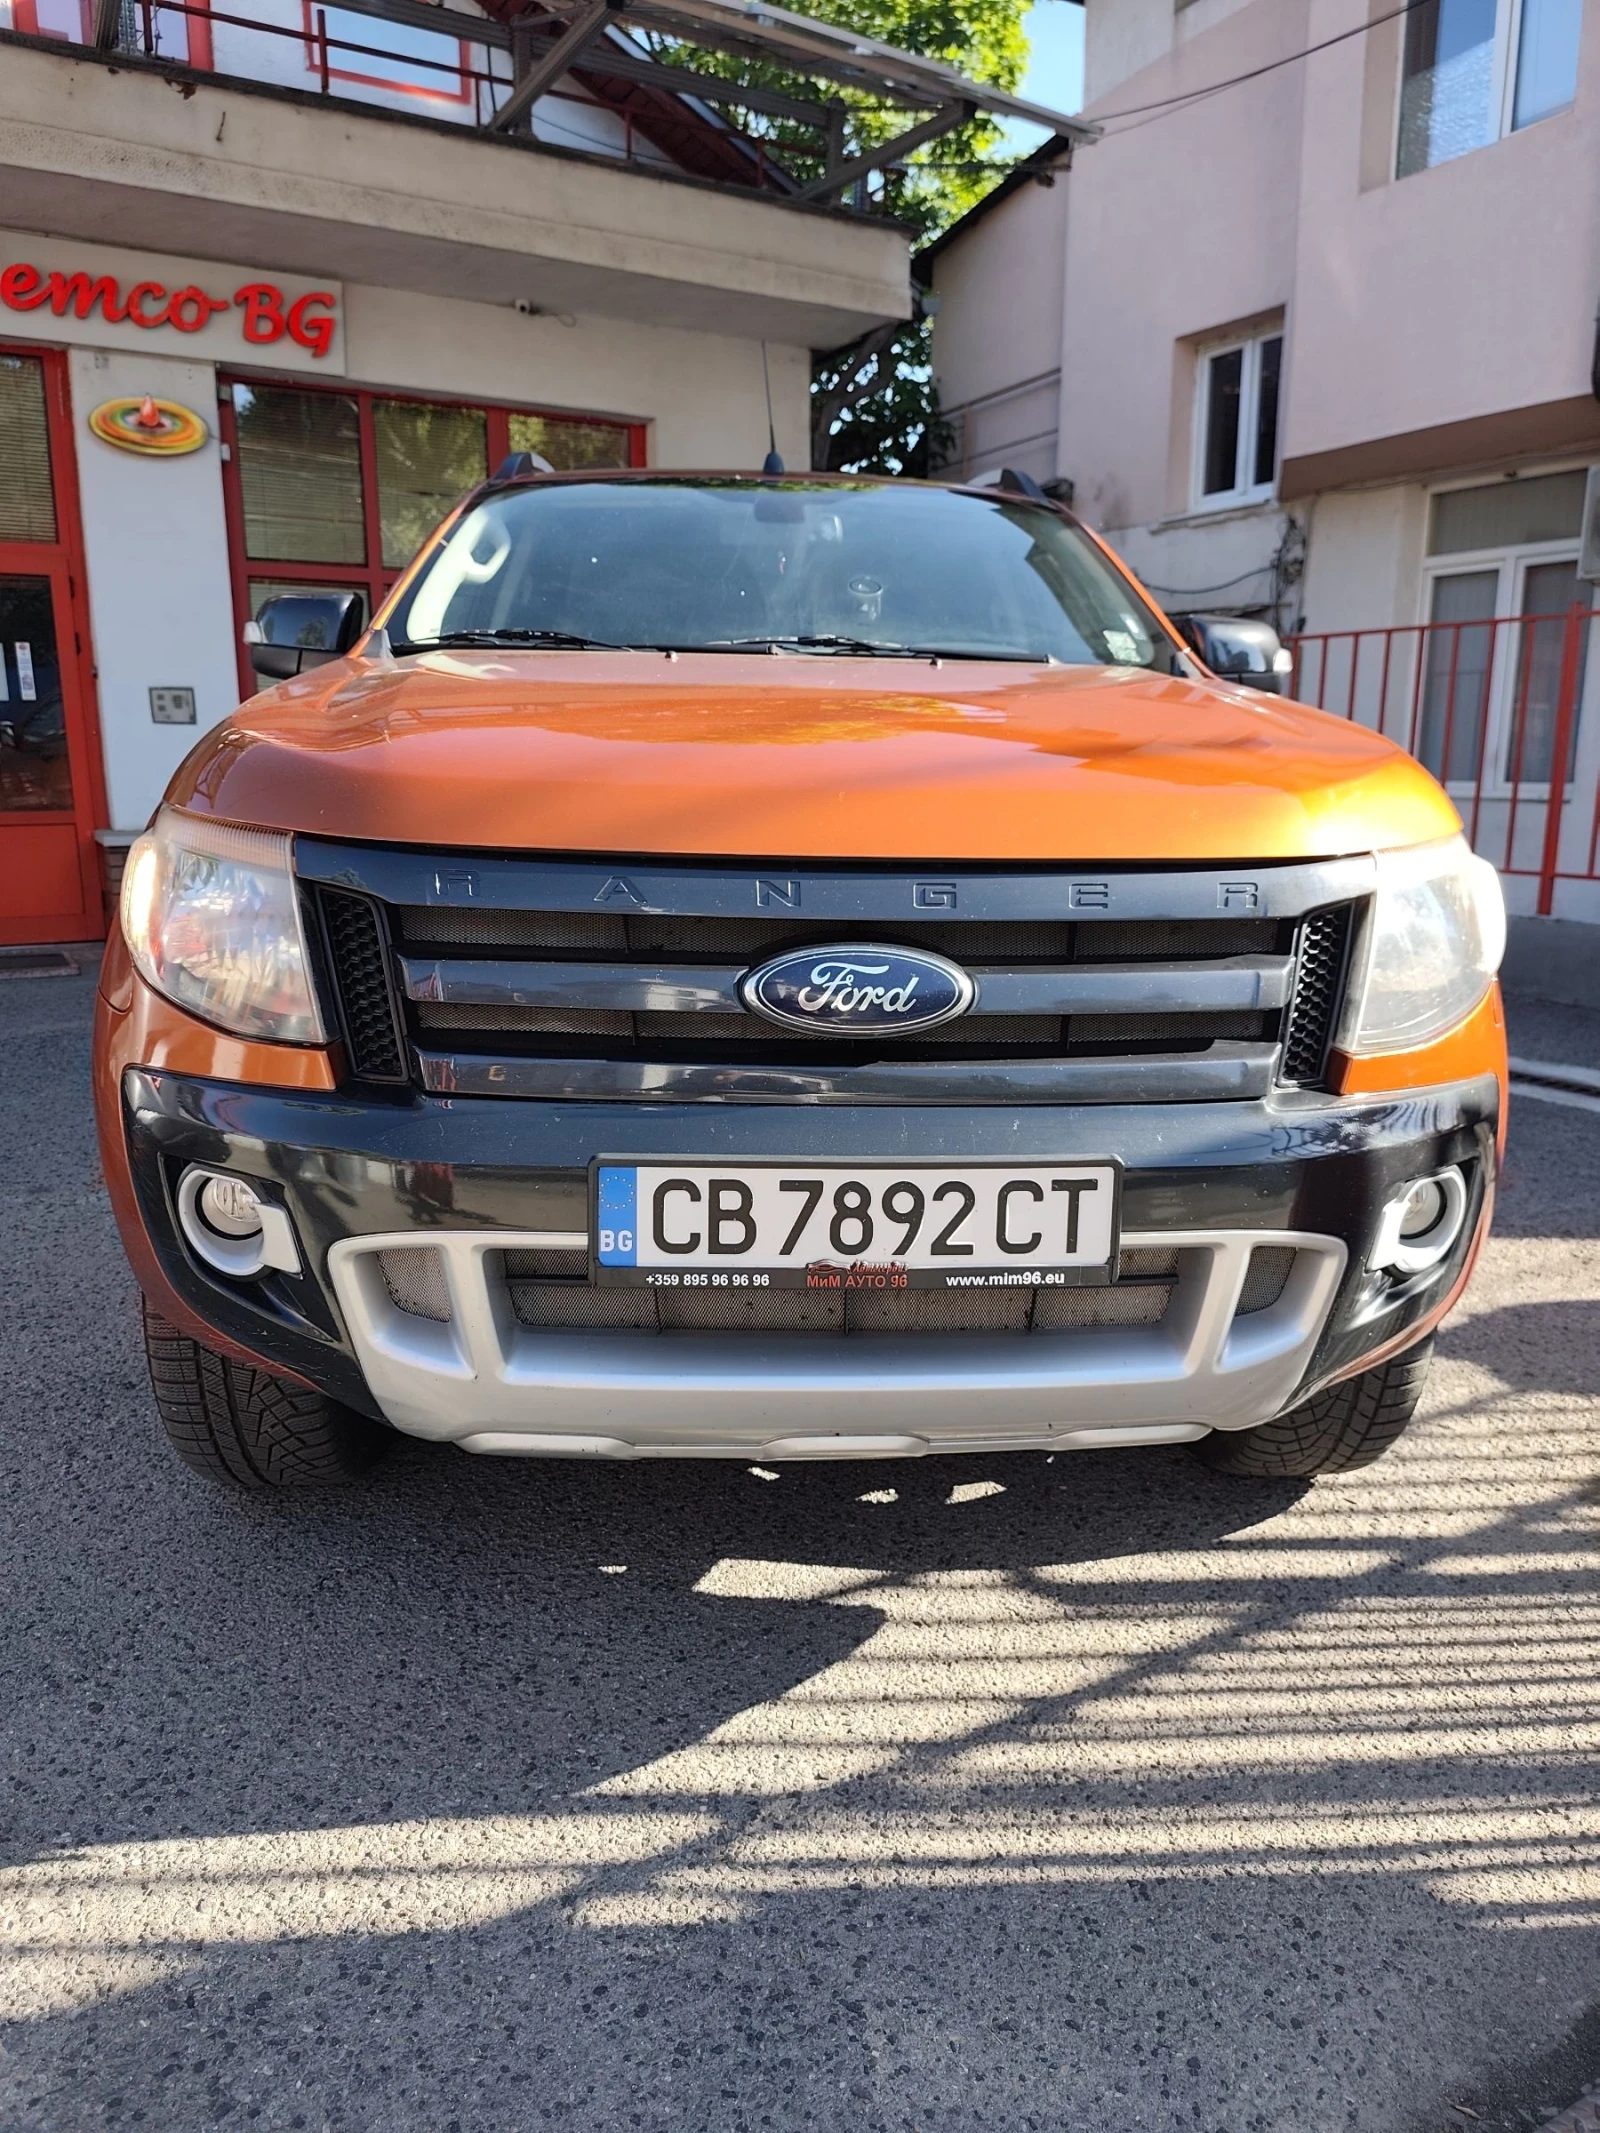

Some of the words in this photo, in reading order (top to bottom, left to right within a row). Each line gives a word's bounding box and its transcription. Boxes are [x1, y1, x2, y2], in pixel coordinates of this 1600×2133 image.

[234, 282, 337, 358] BG
[434, 868, 1260, 909] RANGER
[797, 961, 920, 1012] Ford
[652, 1178, 758, 1255] CB
[778, 1179, 976, 1256] 7892
[995, 1178, 1099, 1255] CT
[600, 1229, 633, 1252] BG
[645, 1273, 680, 1286] +359
[683, 1274, 708, 1286] 895
[711, 1274, 729, 1286] 96
[732, 1274, 749, 1286] 96
[752, 1274, 770, 1286] 96
[806, 1275, 841, 1288] МиМ
[845, 1274, 886, 1288] АУТО
[890, 1274, 908, 1288] 96
[946, 1271, 1065, 1287] www.mim96.eu
